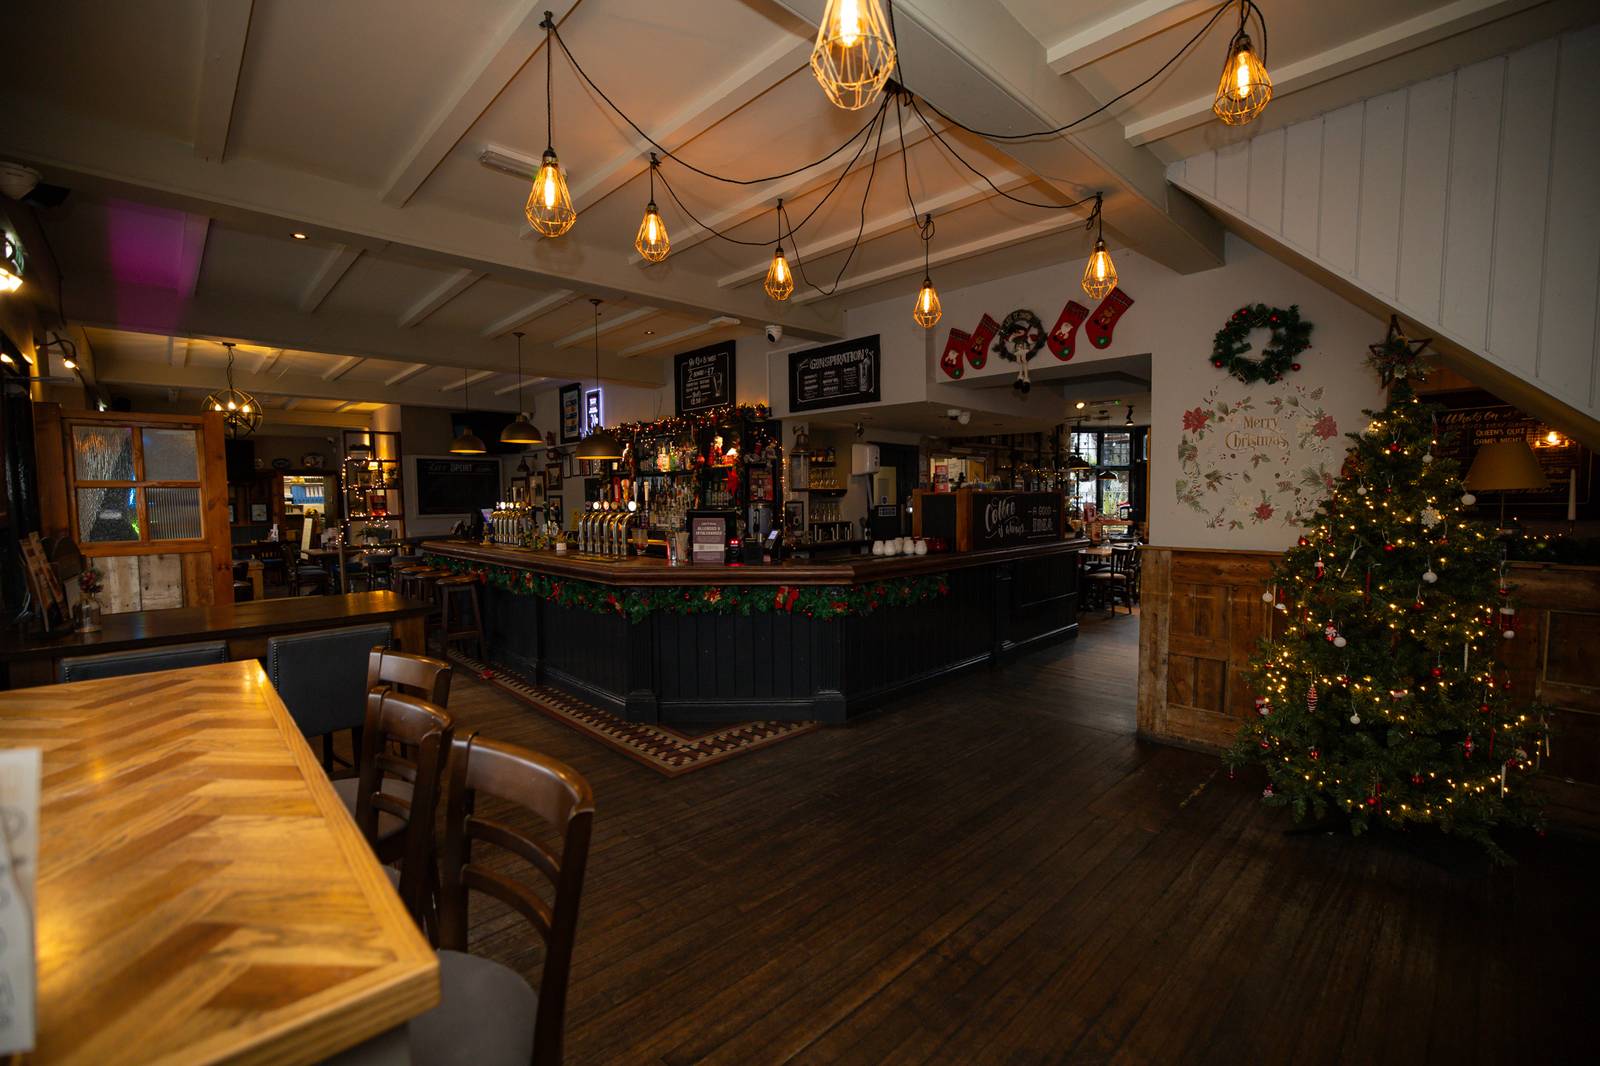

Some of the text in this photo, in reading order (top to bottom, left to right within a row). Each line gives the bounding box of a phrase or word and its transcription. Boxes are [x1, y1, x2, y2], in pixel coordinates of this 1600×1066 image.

[1243, 415, 1281, 431] Merry
[1225, 431, 1290, 450] Christmas
[985, 498, 1016, 533] Coffee
